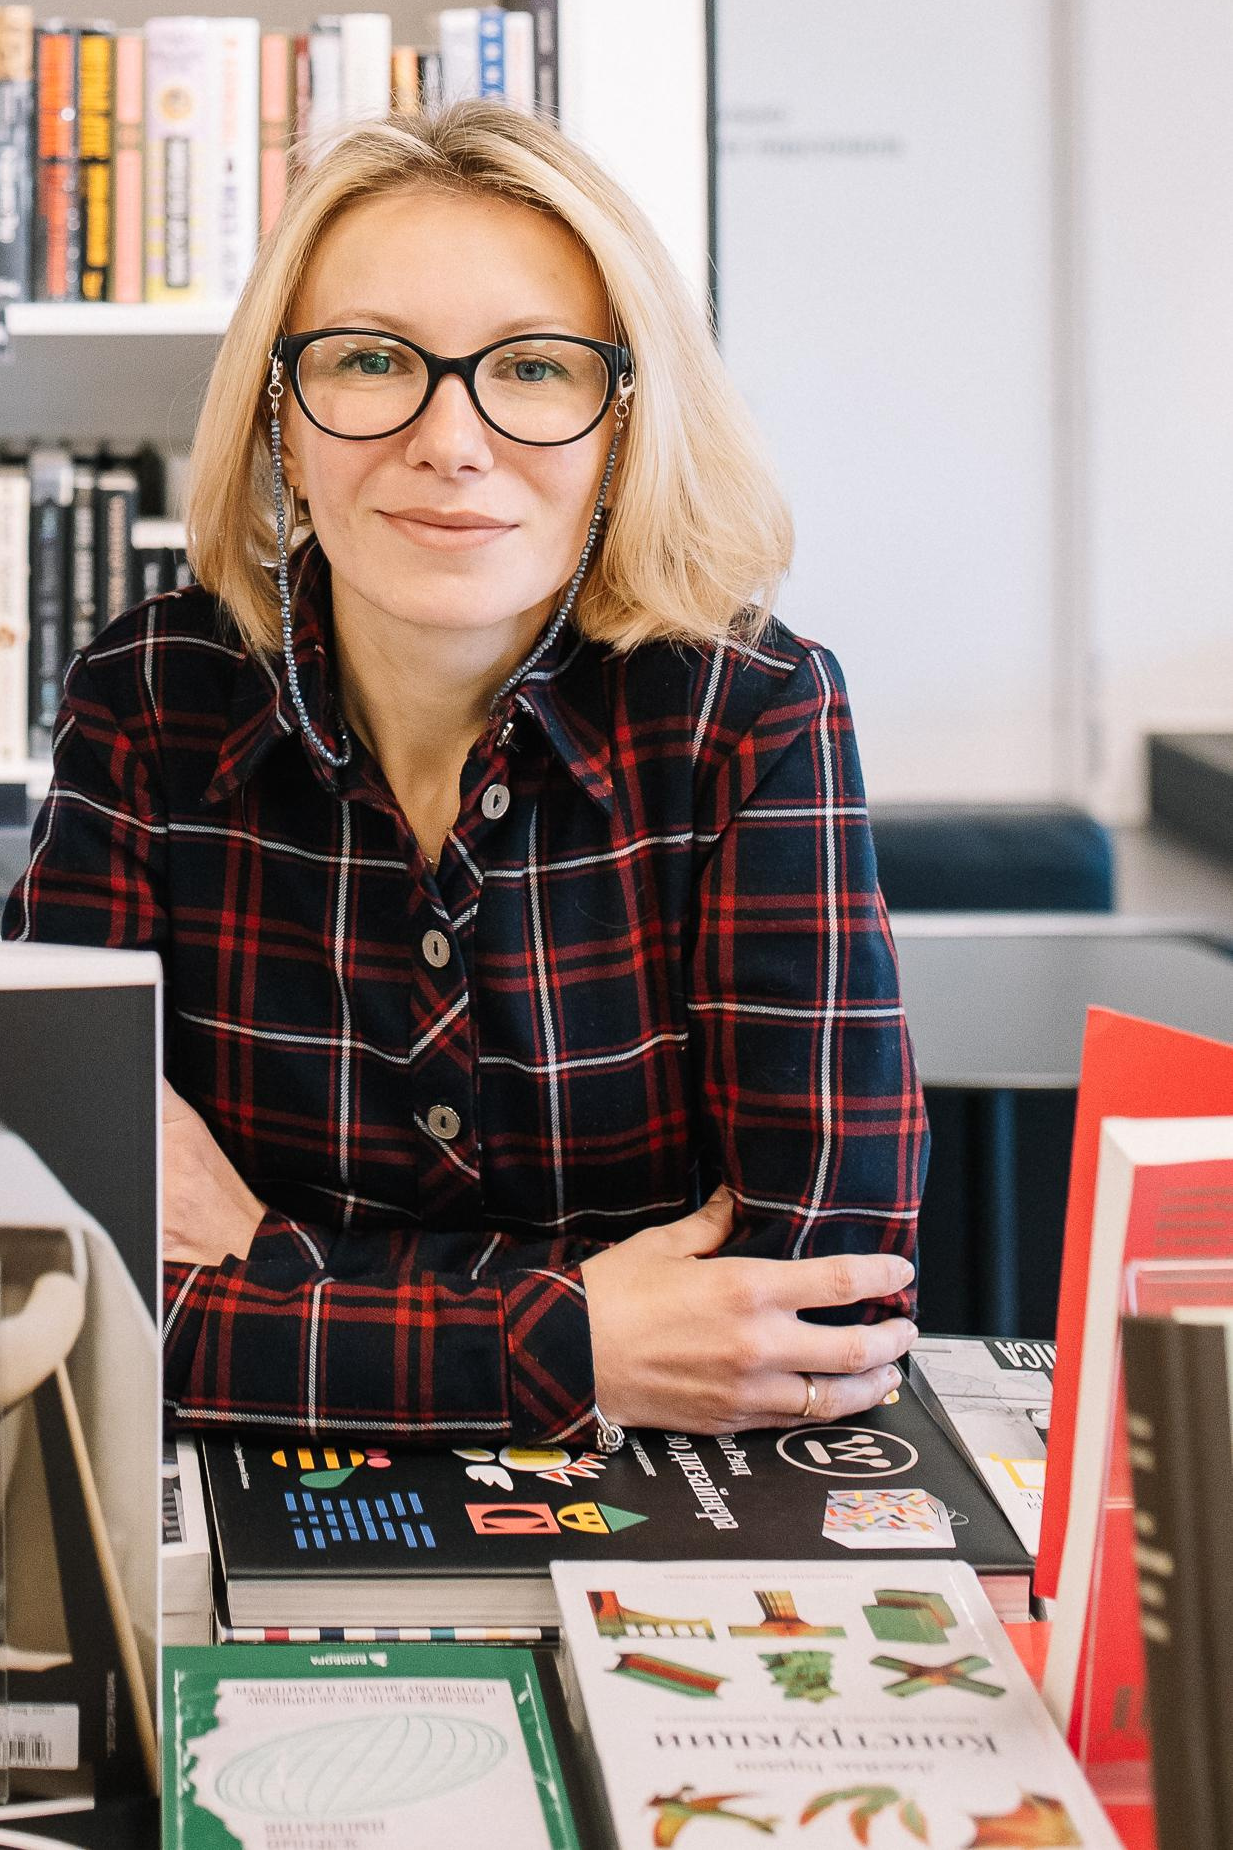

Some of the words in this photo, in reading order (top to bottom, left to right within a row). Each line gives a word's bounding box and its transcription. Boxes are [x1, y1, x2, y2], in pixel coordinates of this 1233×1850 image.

[723, 1450, 752, 1476] Рэнд
[668, 1450, 740, 1531] дизайнера
[652, 1726, 1000, 1757] Конструкции
